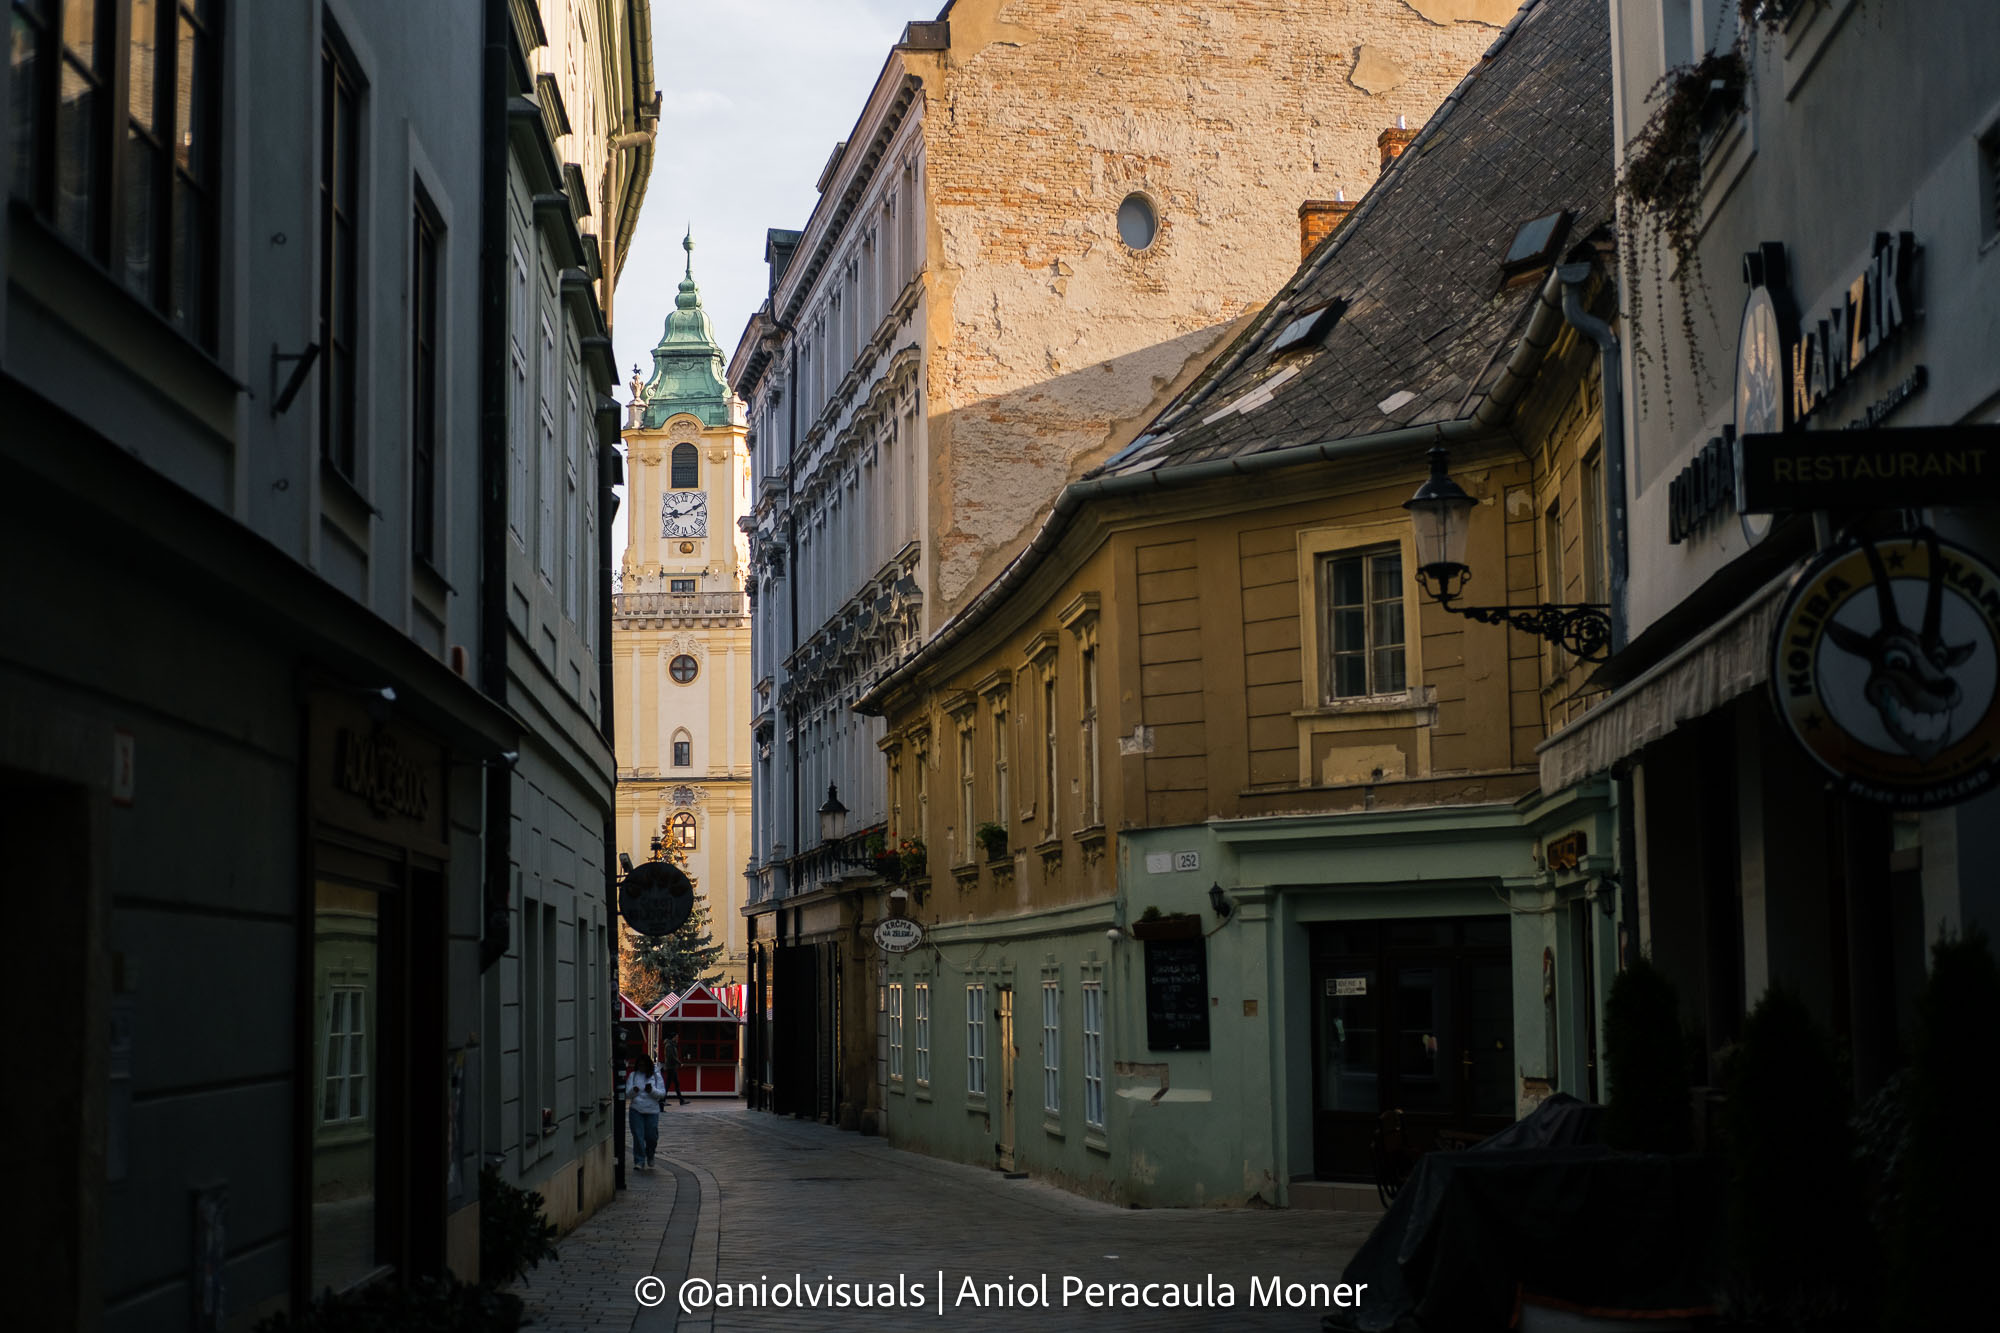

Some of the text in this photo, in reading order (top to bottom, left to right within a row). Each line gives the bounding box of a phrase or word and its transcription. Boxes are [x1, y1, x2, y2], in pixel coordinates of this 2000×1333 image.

[1669, 425, 1736, 544] KOLIBA
[1771, 449, 1987, 482] RESTAURANT
[1792, 556, 2000, 696] KOLIBA KAM
[885, 920, 912, 930] KRČMA
